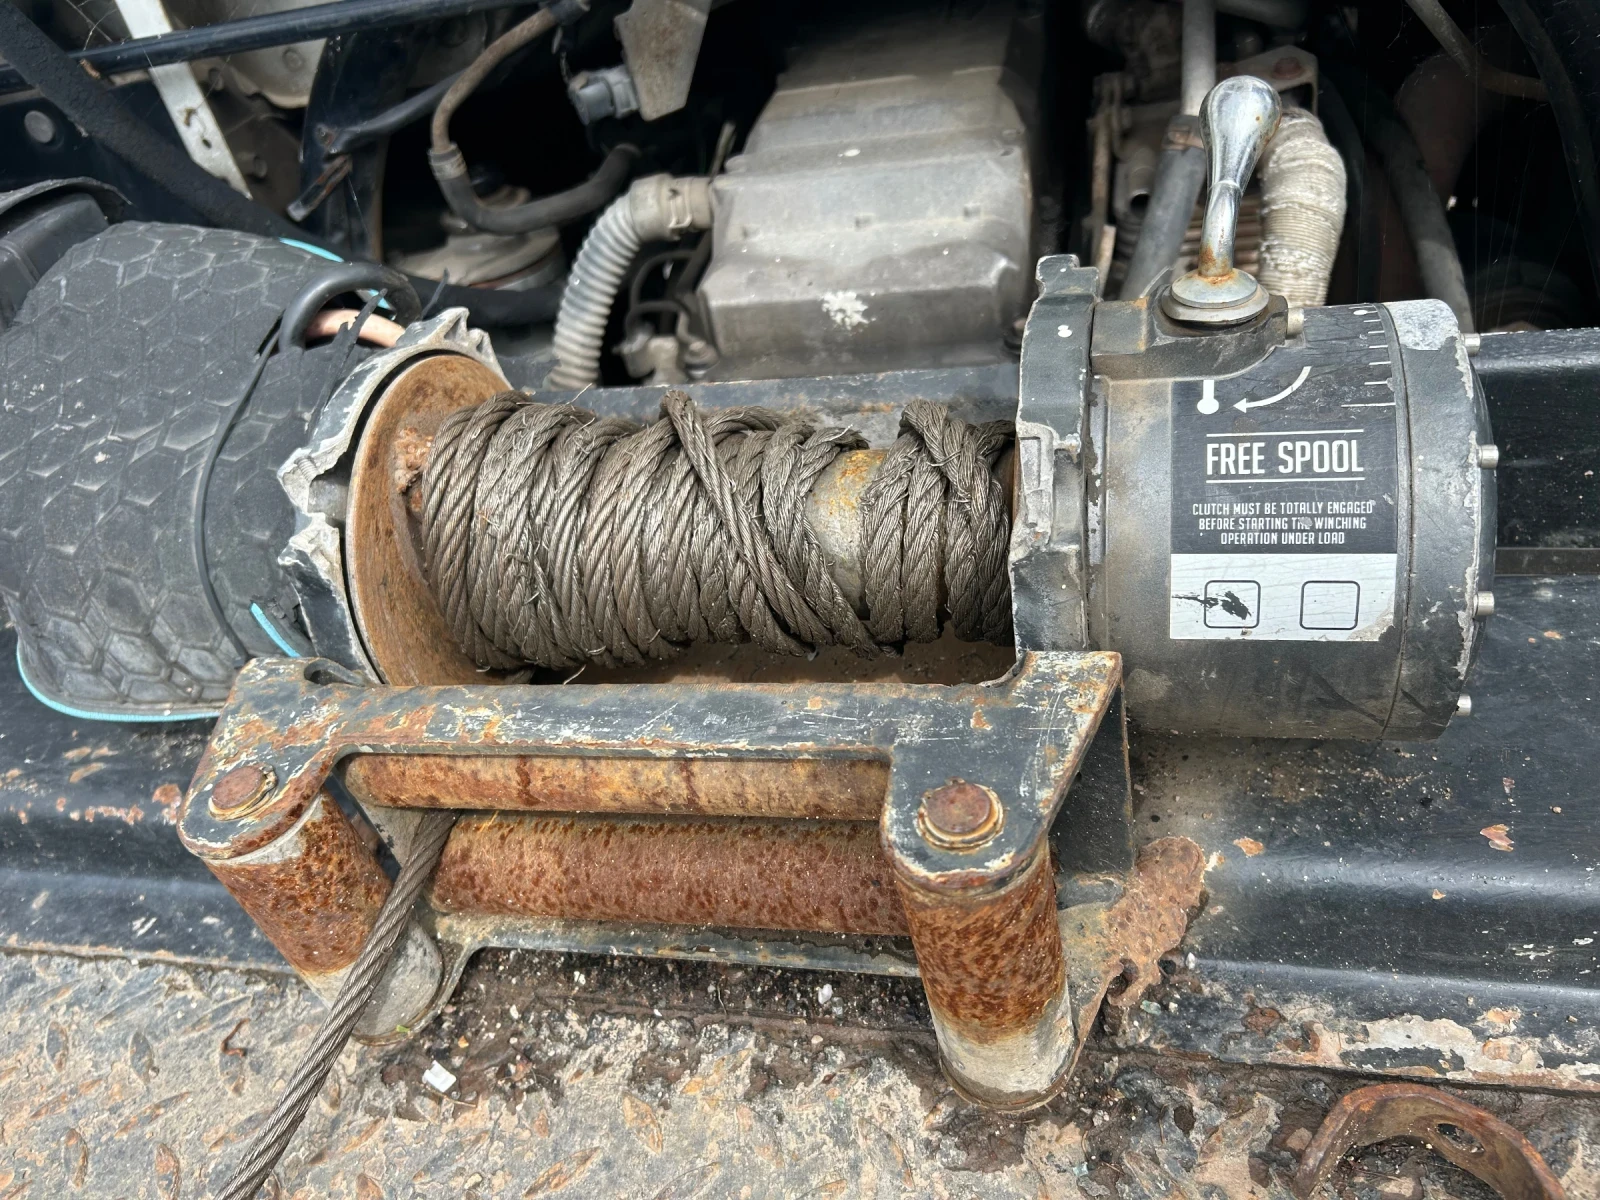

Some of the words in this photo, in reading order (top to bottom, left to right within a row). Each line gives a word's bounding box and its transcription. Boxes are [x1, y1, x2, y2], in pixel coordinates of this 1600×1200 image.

[1206, 442, 1266, 475] FREE
[1278, 439, 1364, 474] SPOOL
[1193, 503, 1230, 516] CLUTCH
[1233, 502, 1260, 515] MUST
[1264, 502, 1277, 515] BE
[1280, 502, 1323, 514] TOTALLY
[1327, 502, 1373, 514] ENGAGED
[1198, 518, 1235, 530] BEFORE
[1238, 517, 1288, 530] STARTING
[1314, 517, 1367, 529] WINCHING
[1220, 532, 1278, 545] OPERATION
[1281, 532, 1315, 545] UNDER
[1318, 532, 1345, 544] LOAD
